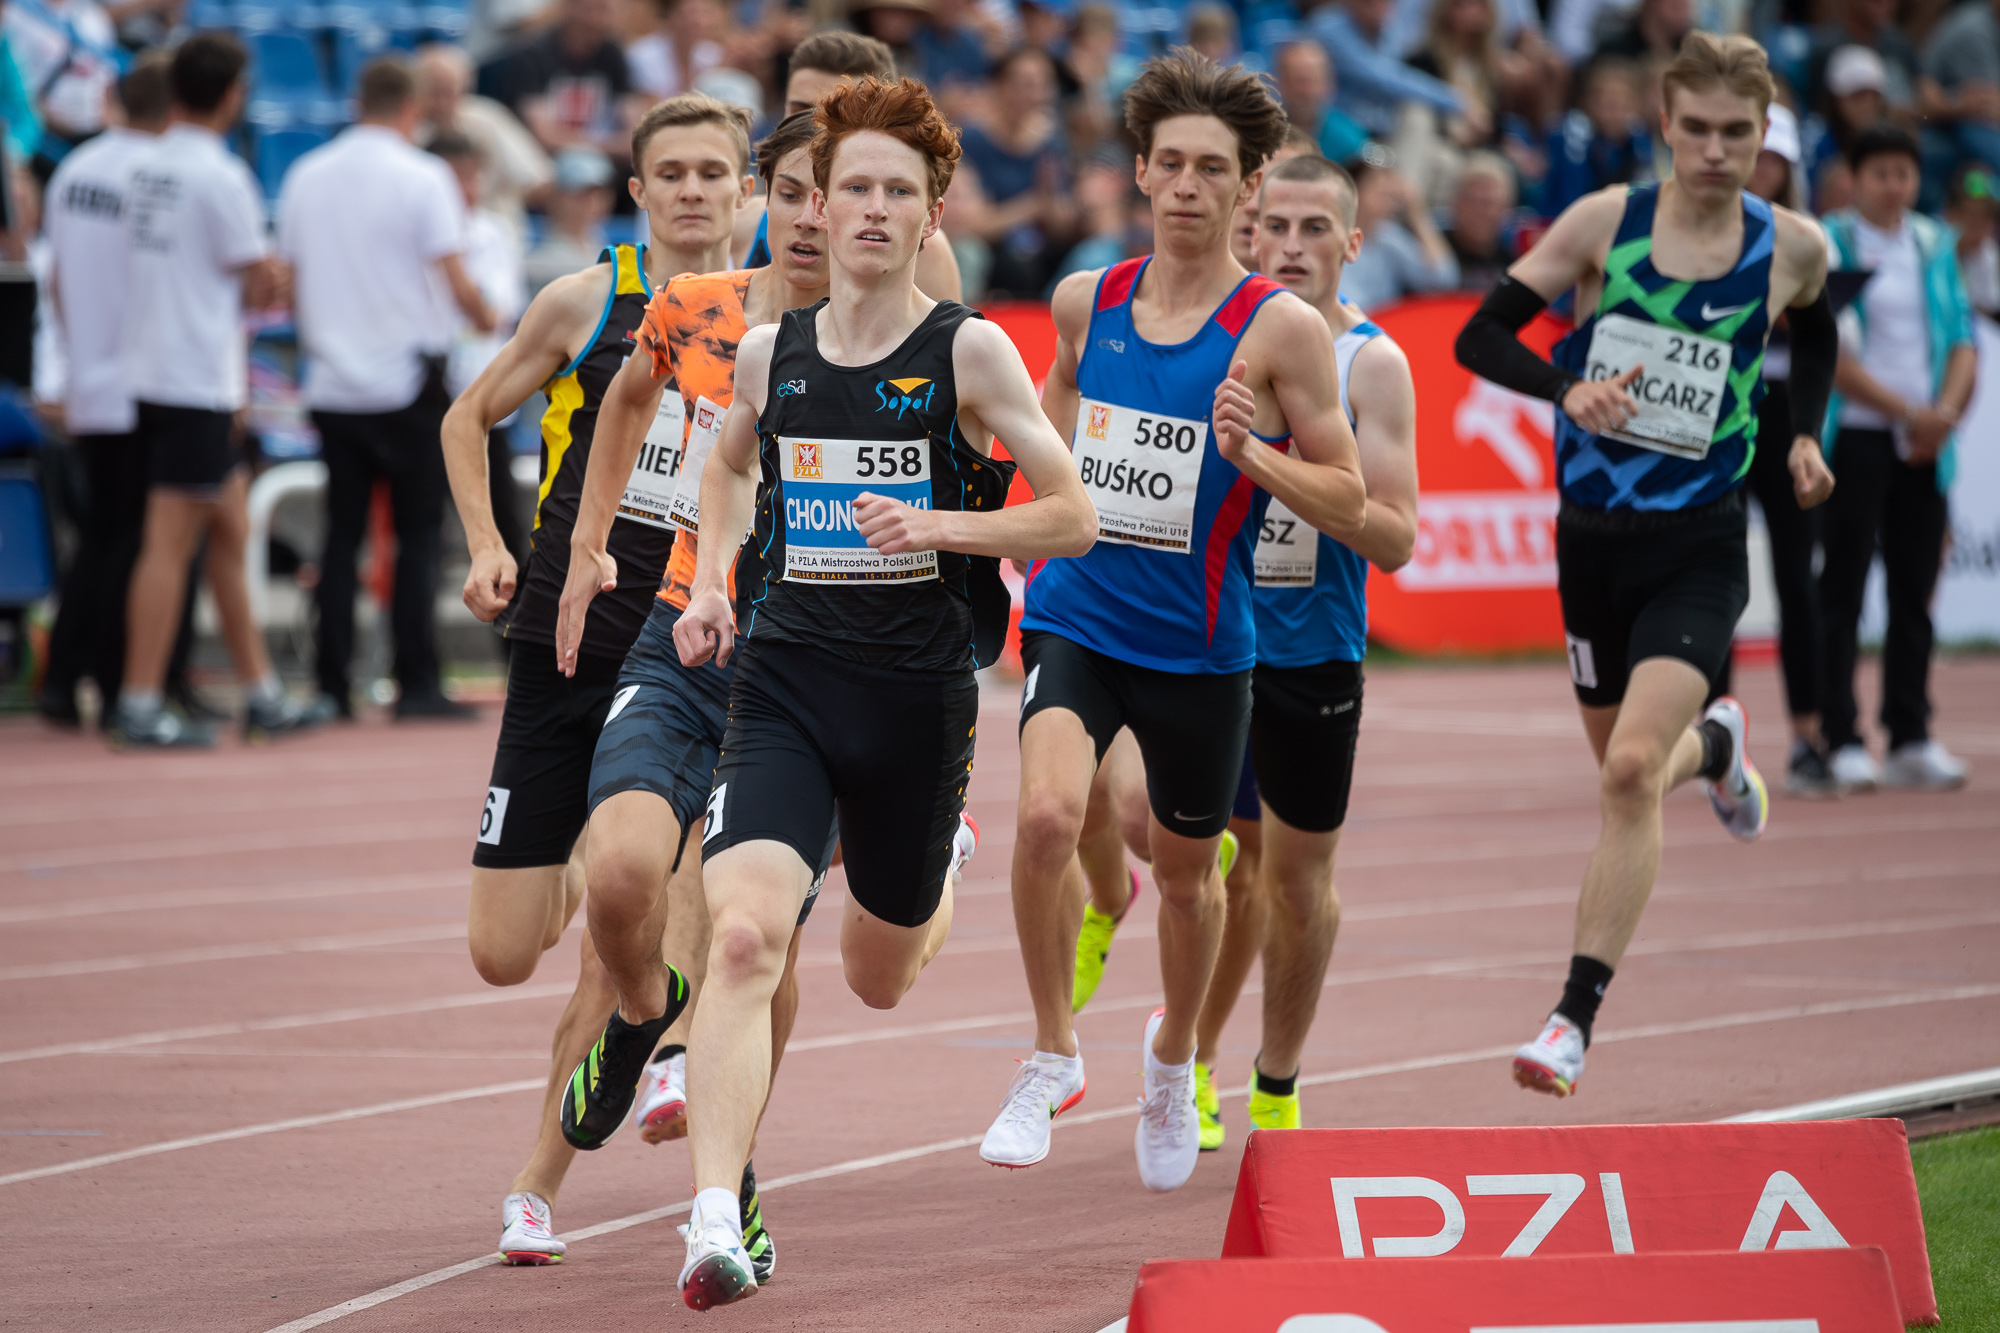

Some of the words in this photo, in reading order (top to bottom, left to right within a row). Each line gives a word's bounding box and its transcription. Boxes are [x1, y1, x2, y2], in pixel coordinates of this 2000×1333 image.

[1665, 336, 1721, 371] 216
[777, 379, 806, 397] esa
[875, 380, 935, 420] Sopot
[1134, 417, 1196, 454] 580
[794, 467, 821, 477] PZLA
[856, 446, 922, 477] 558
[1081, 456, 1173, 501] BUŚKO
[673, 499, 686, 512] 54.
[1140, 522, 1167, 537] Polski
[1170, 527, 1188, 538] U18
[788, 554, 797, 565] 54.
[798, 556, 818, 567] PZLA
[821, 557, 880, 568] Mistrzostwa
[883, 555, 913, 567] Polski
[916, 552, 935, 564] U18
[789, 569, 848, 580] BIELSKO-BIAŁA
[865, 567, 933, 580] 15-17.07.2022
[480, 790, 496, 838] 6
